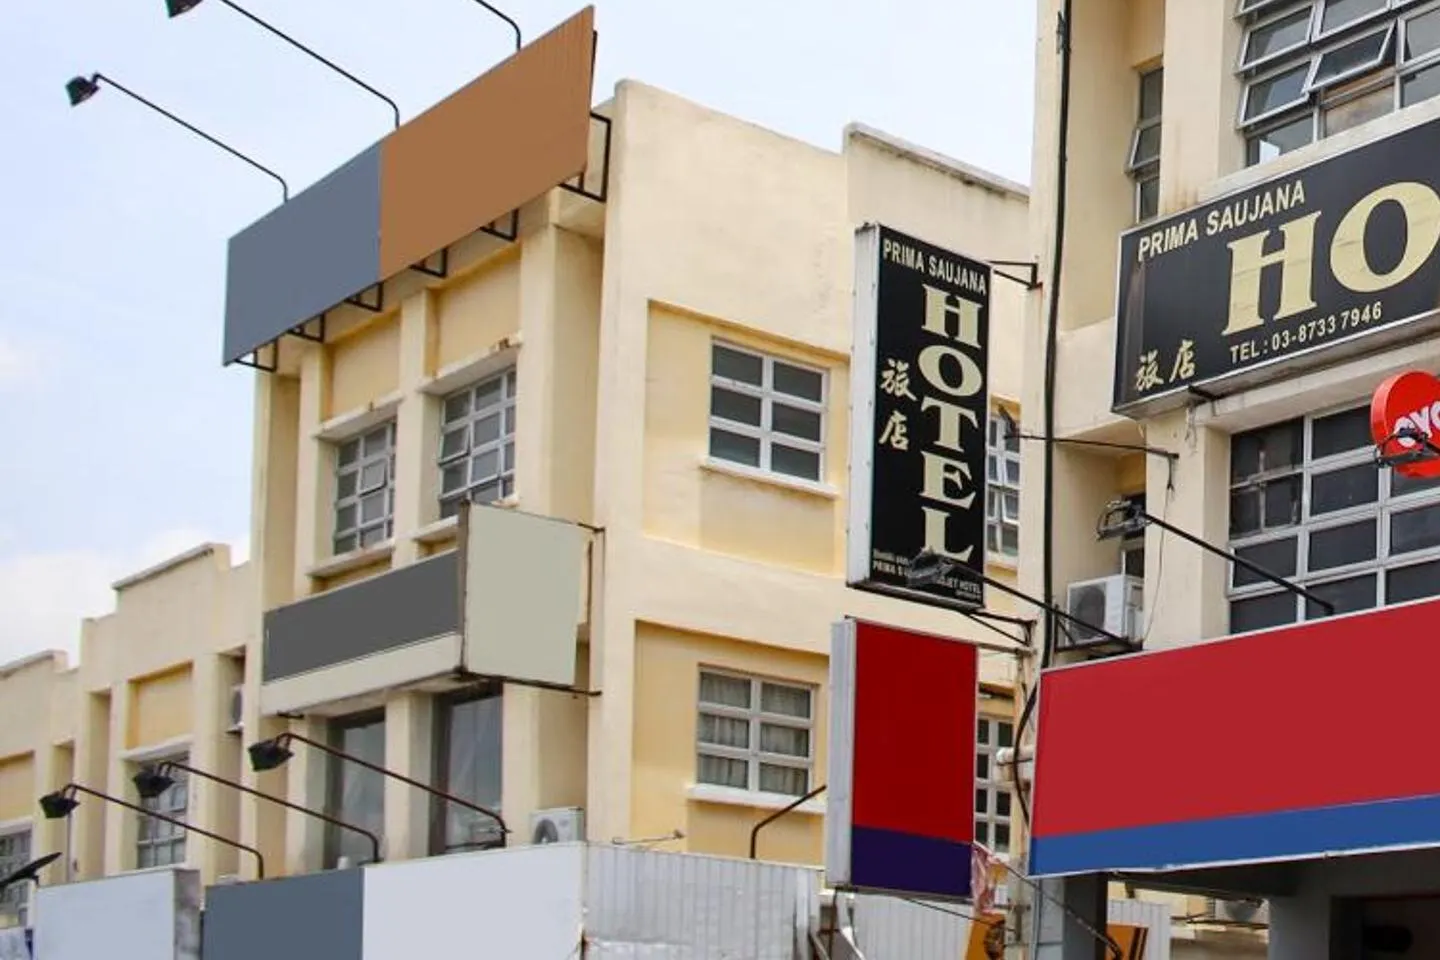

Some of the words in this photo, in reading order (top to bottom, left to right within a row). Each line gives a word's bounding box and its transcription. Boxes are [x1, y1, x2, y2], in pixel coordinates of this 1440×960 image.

[1138, 218, 1198, 262] PRIMA
[1206, 180, 1306, 236] SAUJANA
[883, 238, 925, 273] PRIMA
[928, 255, 986, 296] SAUJANA
[1272, 315, 1336, 350] 03-8733
[1340, 301, 1382, 331] 7946
[877, 357, 919, 451] 旅店
[917, 283, 983, 564] HOTEL
